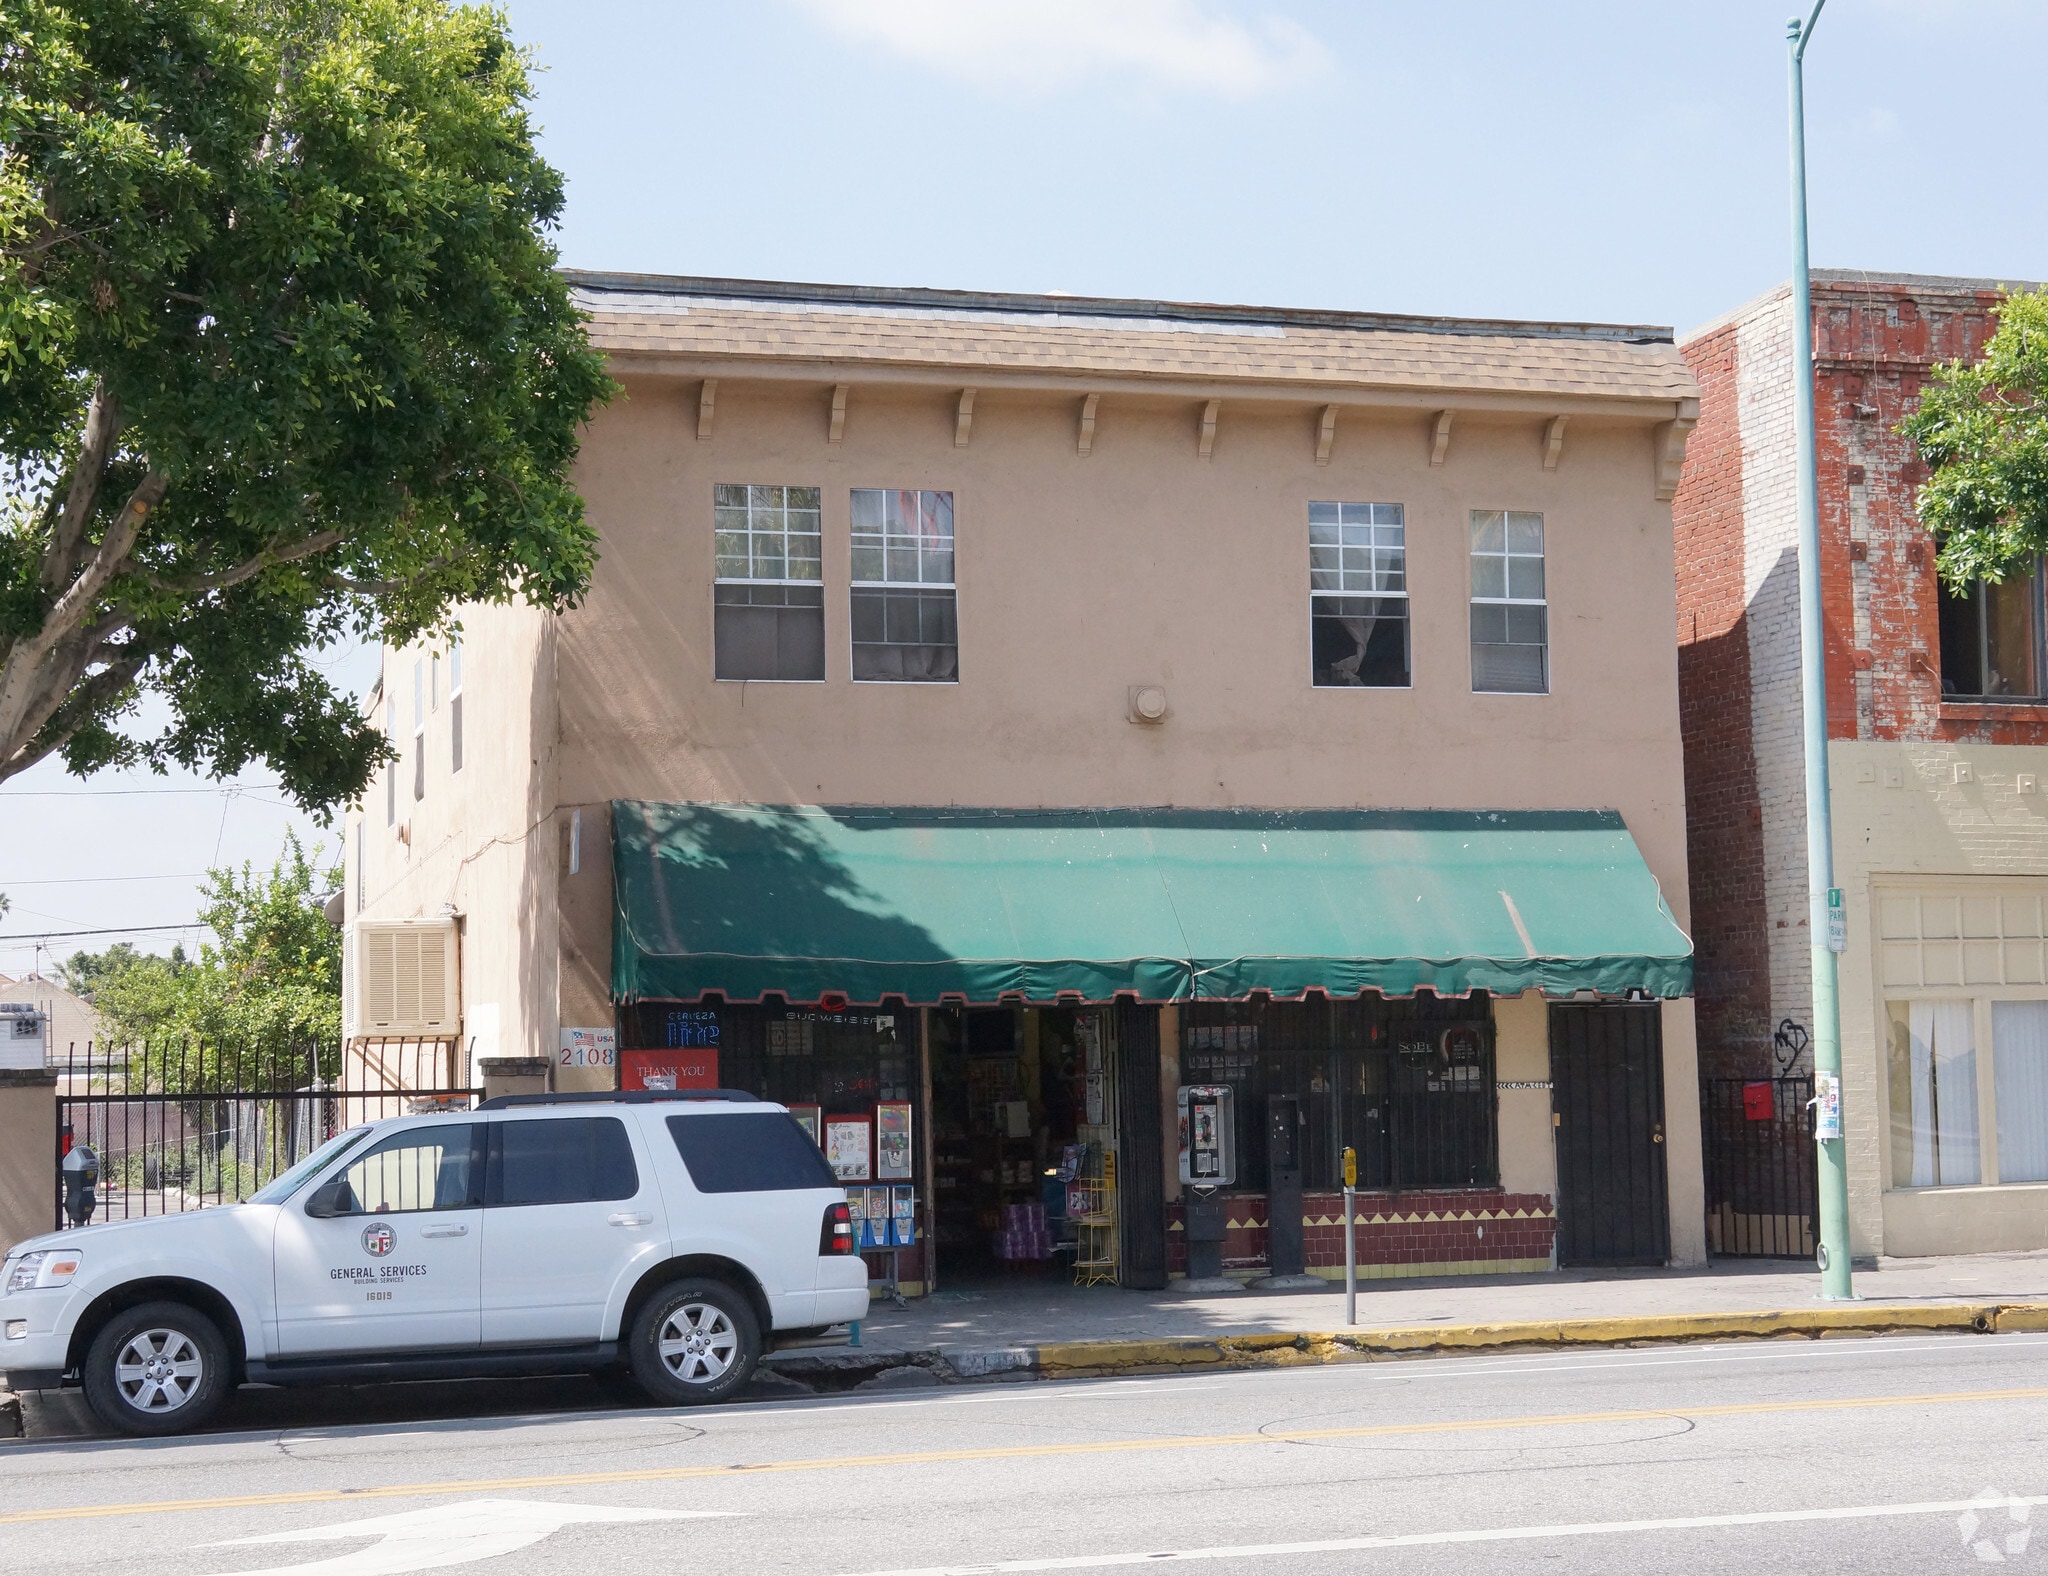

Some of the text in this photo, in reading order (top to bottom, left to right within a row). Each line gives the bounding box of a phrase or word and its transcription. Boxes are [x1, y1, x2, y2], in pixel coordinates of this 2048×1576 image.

[597, 1035, 614, 1043] USA
[561, 1048, 614, 1065] 2108
[637, 1066, 705, 1077] THANK YOU
[330, 1265, 427, 1280] GENERAL SERVICES
[366, 1291, 393, 1301] 16019
